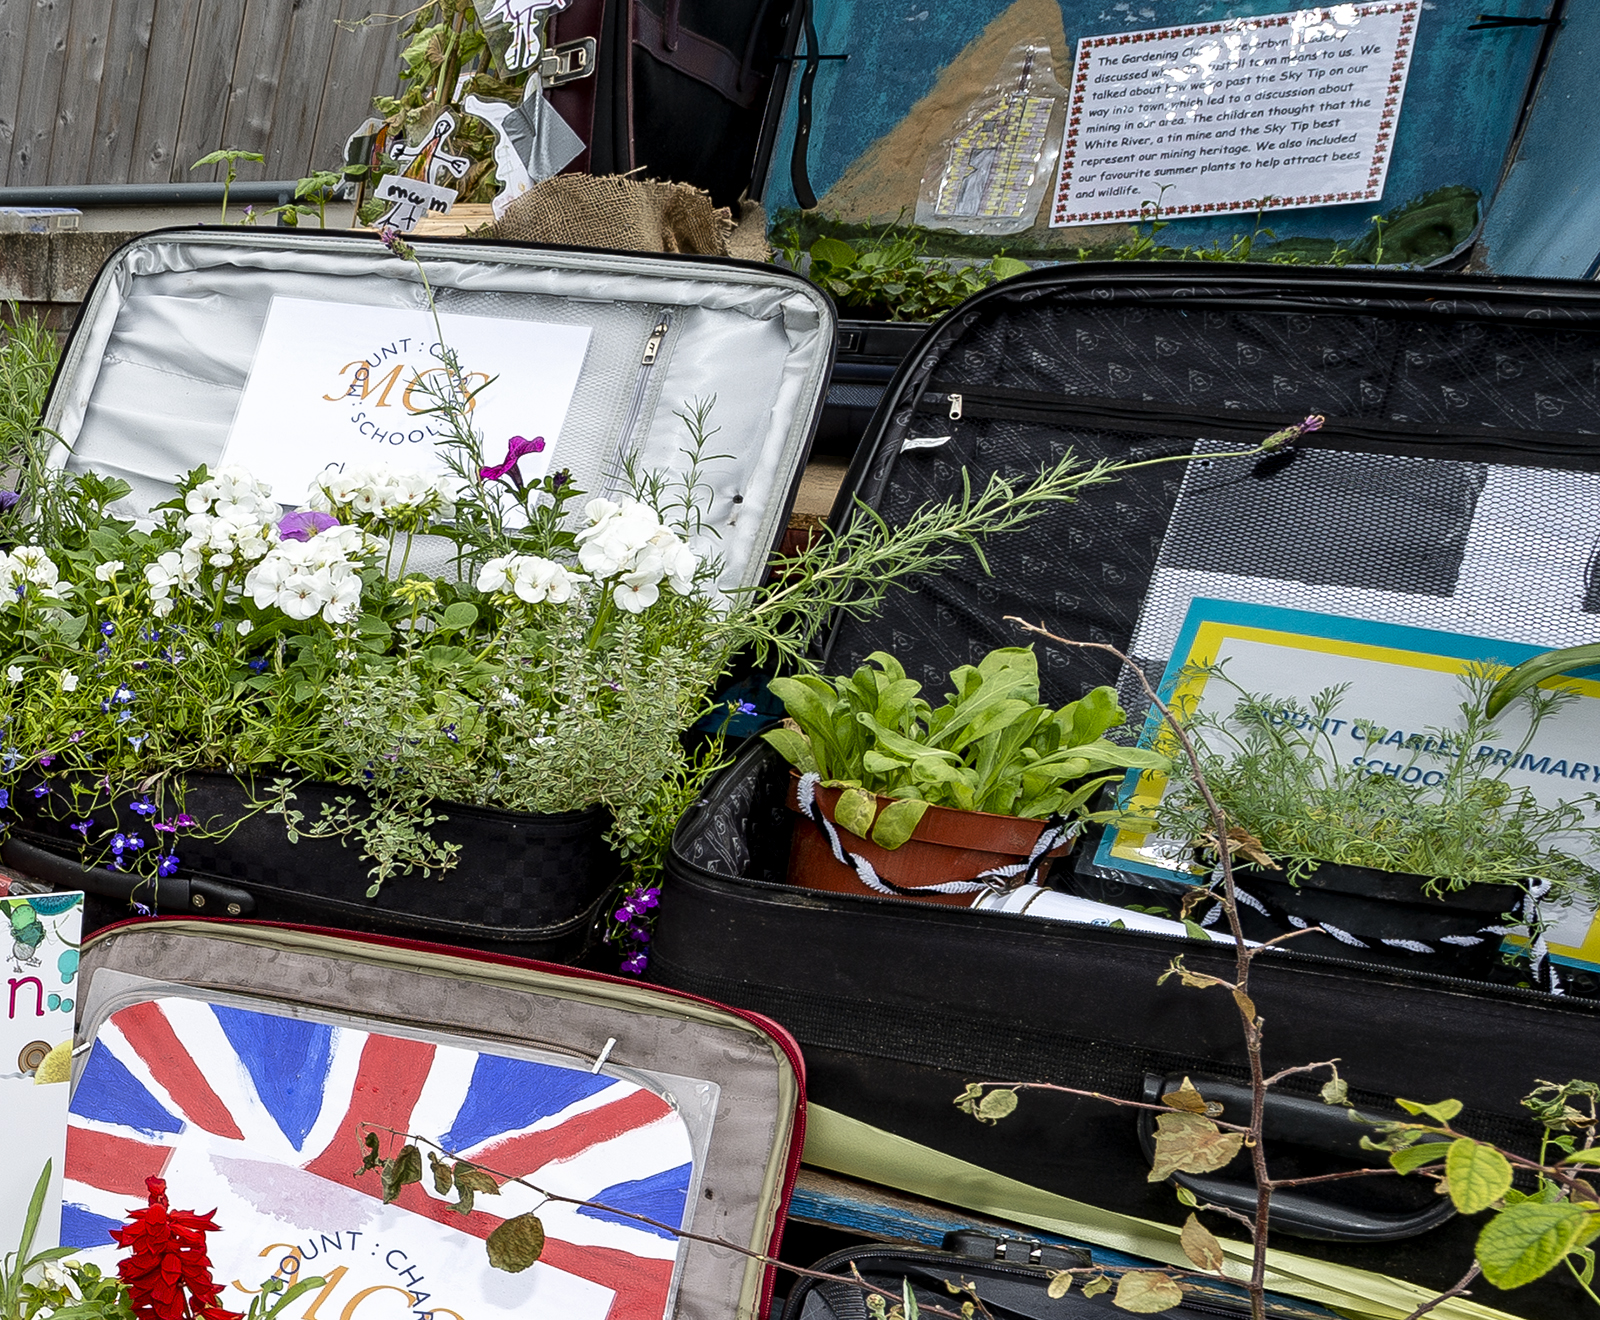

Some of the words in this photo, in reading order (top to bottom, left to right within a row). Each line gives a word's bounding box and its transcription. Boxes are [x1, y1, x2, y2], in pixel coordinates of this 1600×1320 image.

[1094, 70, 1148, 84] discussed
[1322, 49, 1335, 60] to
[1338, 47, 1356, 58] us.
[1360, 44, 1381, 56] We
[1098, 56, 1118, 67] The
[1122, 50, 1179, 65] Gardening
[1088, 107, 1110, 119] way
[1138, 102, 1168, 113] town,
[1171, 97, 1203, 110] which
[1207, 95, 1225, 105] led
[1229, 93, 1241, 104] to
[1243, 94, 1251, 103] a
[1254, 87, 1315, 101] discussion
[1318, 82, 1355, 95] about
[1092, 88, 1127, 101] talked
[1129, 85, 1162, 98] about
[1190, 80, 1206, 91] we
[1225, 76, 1253, 89] past
[1256, 72, 1276, 83] the
[1279, 70, 1303, 85] Sky
[1307, 68, 1326, 80] Tip
[1329, 67, 1344, 76] on
[1347, 64, 1368, 74] our
[1084, 139, 1118, 150] White
[1121, 135, 1154, 147] River,
[1156, 136, 1164, 145] a
[1167, 132, 1183, 142] tin
[1186, 131, 1212, 141] mine
[1215, 127, 1236, 139] and
[1239, 125, 1260, 136] the
[1263, 123, 1287, 135] Sky
[1290, 121, 1309, 133] Tip
[1312, 117, 1341, 129] best
[1086, 121, 1121, 134] mining
[1124, 120, 1134, 130] in
[1137, 118, 1156, 129] our
[1158, 116, 1187, 127] area.
[1193, 112, 1213, 124] The
[1216, 109, 1264, 122] children
[1268, 103, 1315, 118] thought
[1319, 101, 1346, 112] that
[1350, 98, 1372, 108] the
[1078, 173, 1098, 183] our
[1099, 168, 1152, 183] favourite
[1153, 165, 1199, 178] summer
[1200, 161, 1236, 176] plants
[1240, 159, 1253, 170] to
[1255, 156, 1281, 169] help
[1283, 154, 1329, 166] attract
[1331, 149, 1362, 161] bees
[1081, 153, 1136, 167] represent
[1138, 152, 1157, 162] our
[1160, 148, 1196, 161] mining
[1199, 143, 1252, 157] heritage.
[1256, 140, 1276, 152] We
[1278, 137, 1302, 149] also
[1305, 132, 1358, 148] included
[1075, 187, 1096, 199] and
[1098, 184, 1142, 198] wildlife.
[347, 338, 412, 398] MOUNT
[322, 360, 491, 417] MCS
[351, 411, 440, 446] SCHOOL
[1474, 745, 1600, 784] PRIMARY
